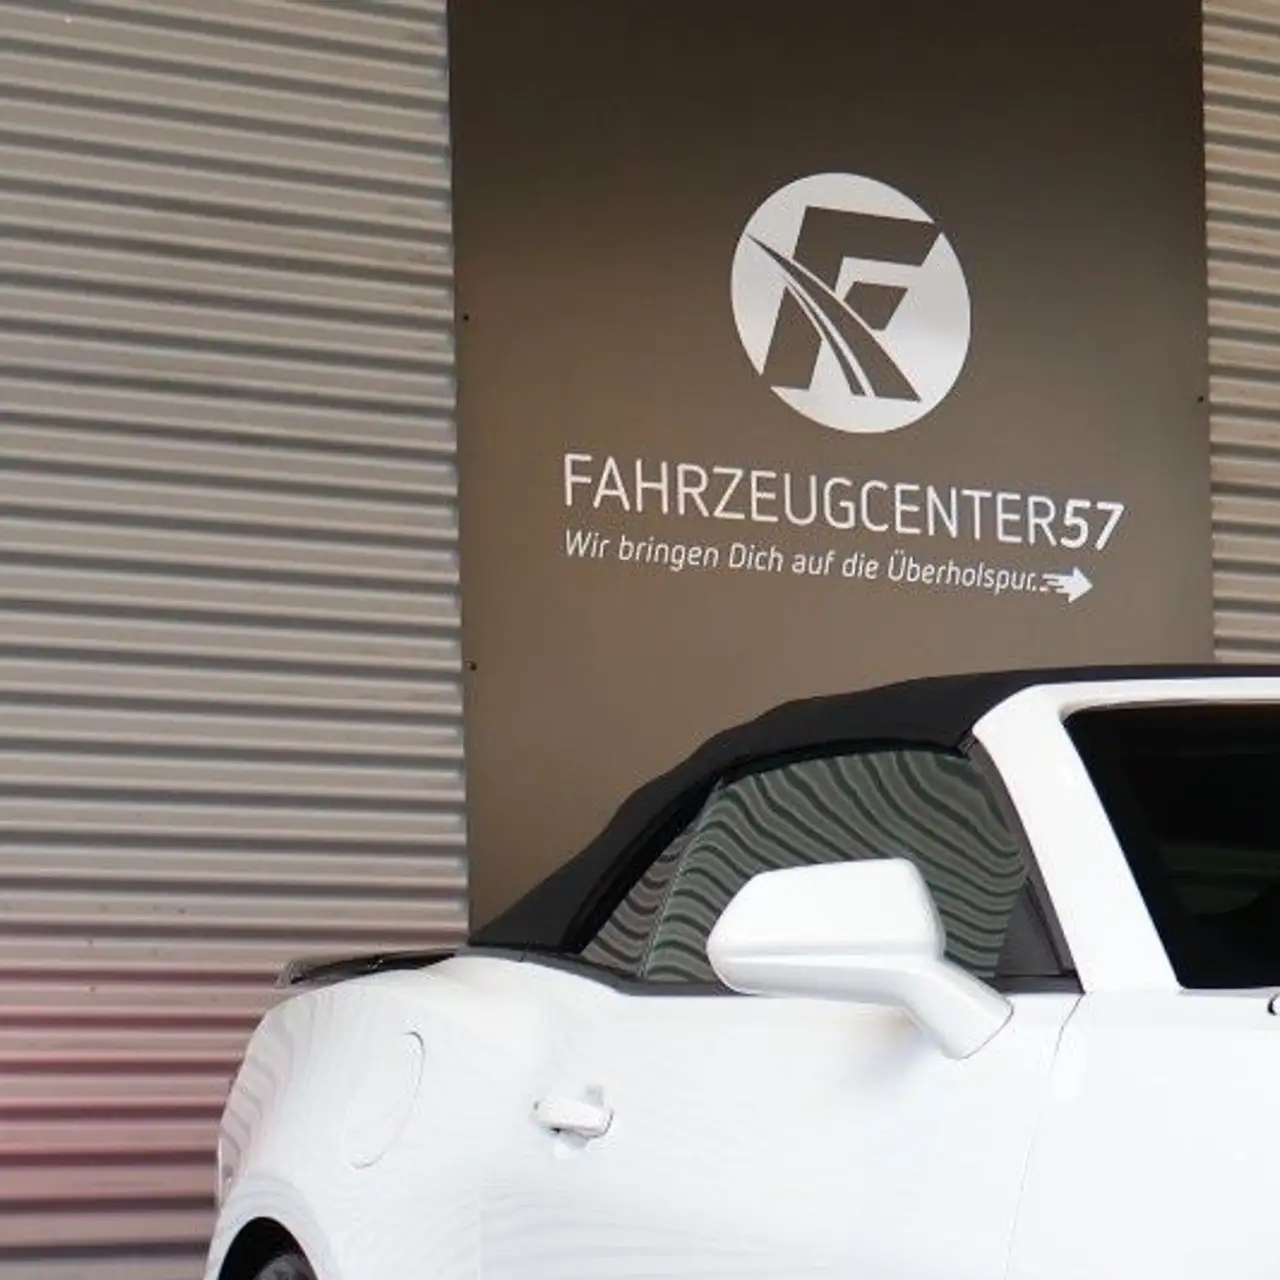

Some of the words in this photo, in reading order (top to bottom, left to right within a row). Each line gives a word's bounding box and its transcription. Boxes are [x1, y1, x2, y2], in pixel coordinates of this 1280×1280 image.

[563, 453, 1124, 551] FAHRZEUGCENTER57
[565, 529, 610, 558] Wir
[618, 535, 719, 572] bringen
[728, 542, 784, 573] Dich
[791, 550, 835, 575] auf
[841, 552, 879, 580] die
